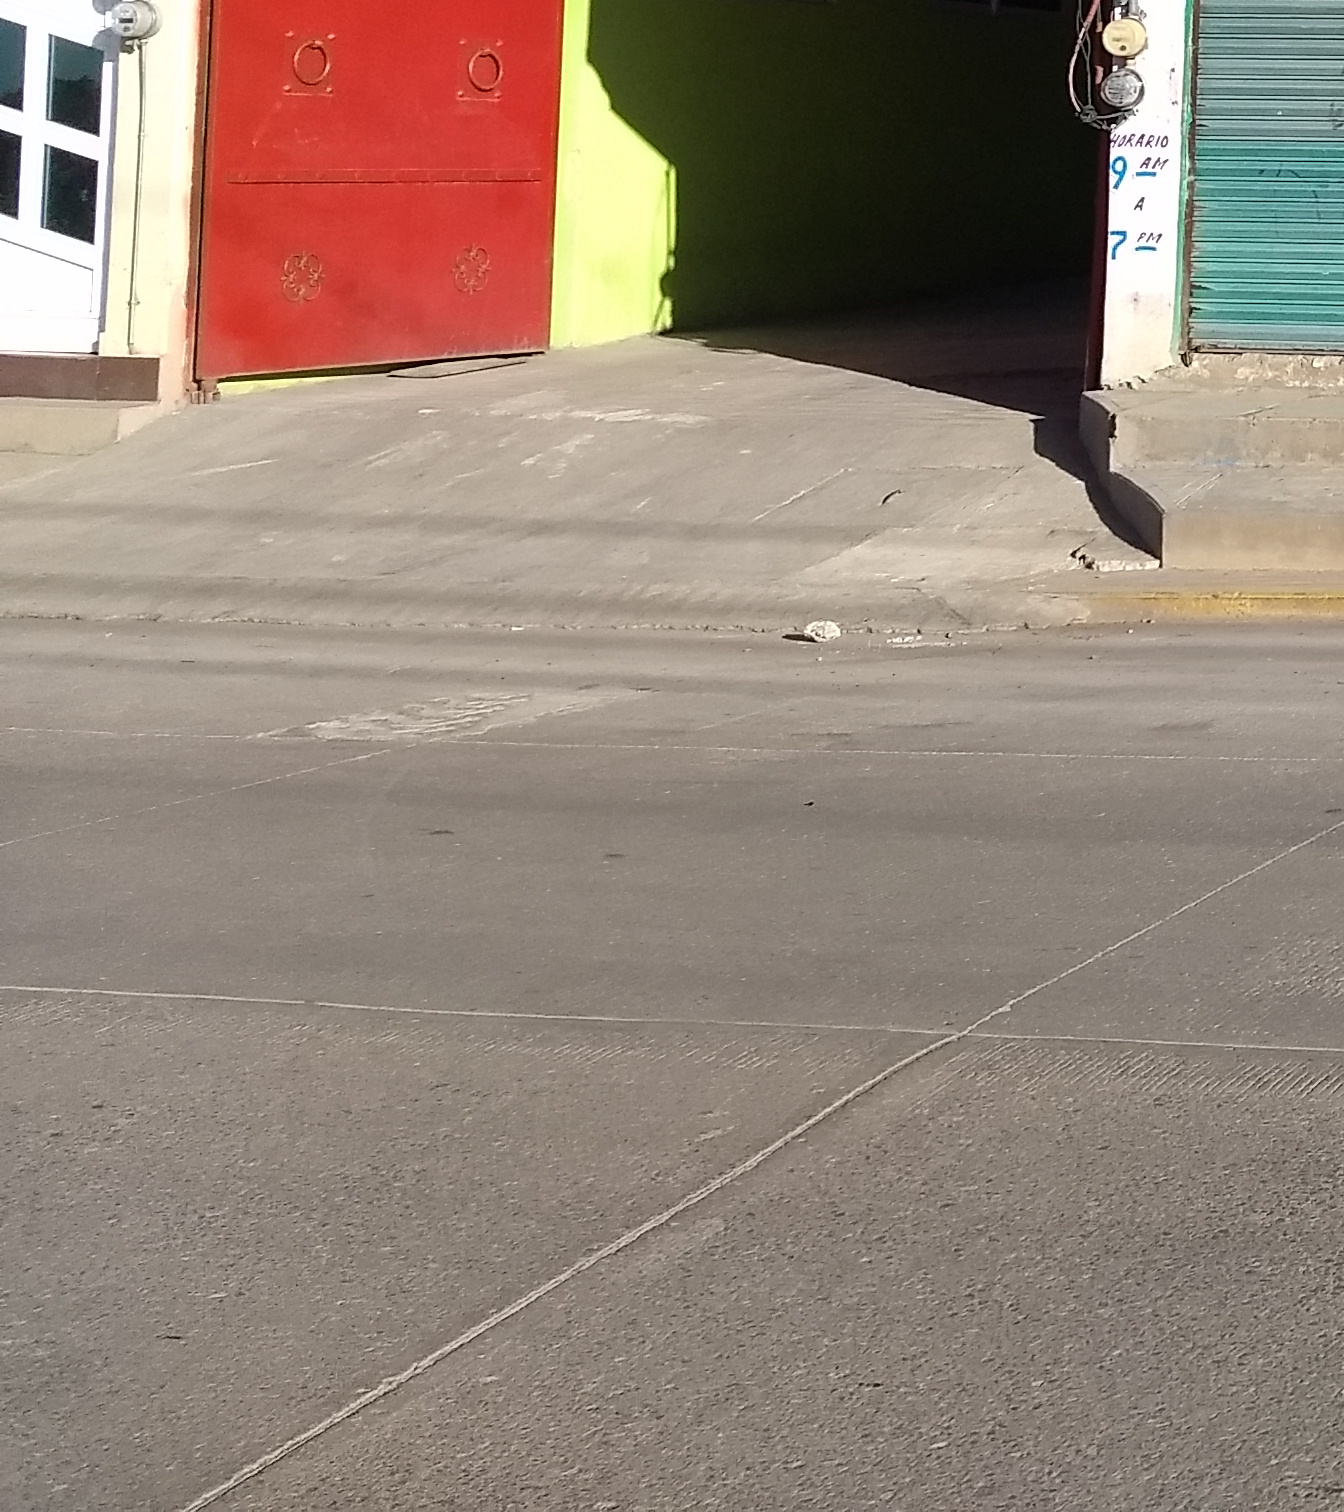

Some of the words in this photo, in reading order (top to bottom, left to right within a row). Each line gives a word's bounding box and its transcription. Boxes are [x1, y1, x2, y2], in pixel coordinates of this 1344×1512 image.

[1110, 133, 1169, 148] HORARIO
[1111, 155, 1128, 190] 9
[1139, 157, 1169, 170] AM
[1133, 196, 1145, 211] A
[1110, 230, 1128, 260] 7
[1137, 232, 1163, 243] PM
